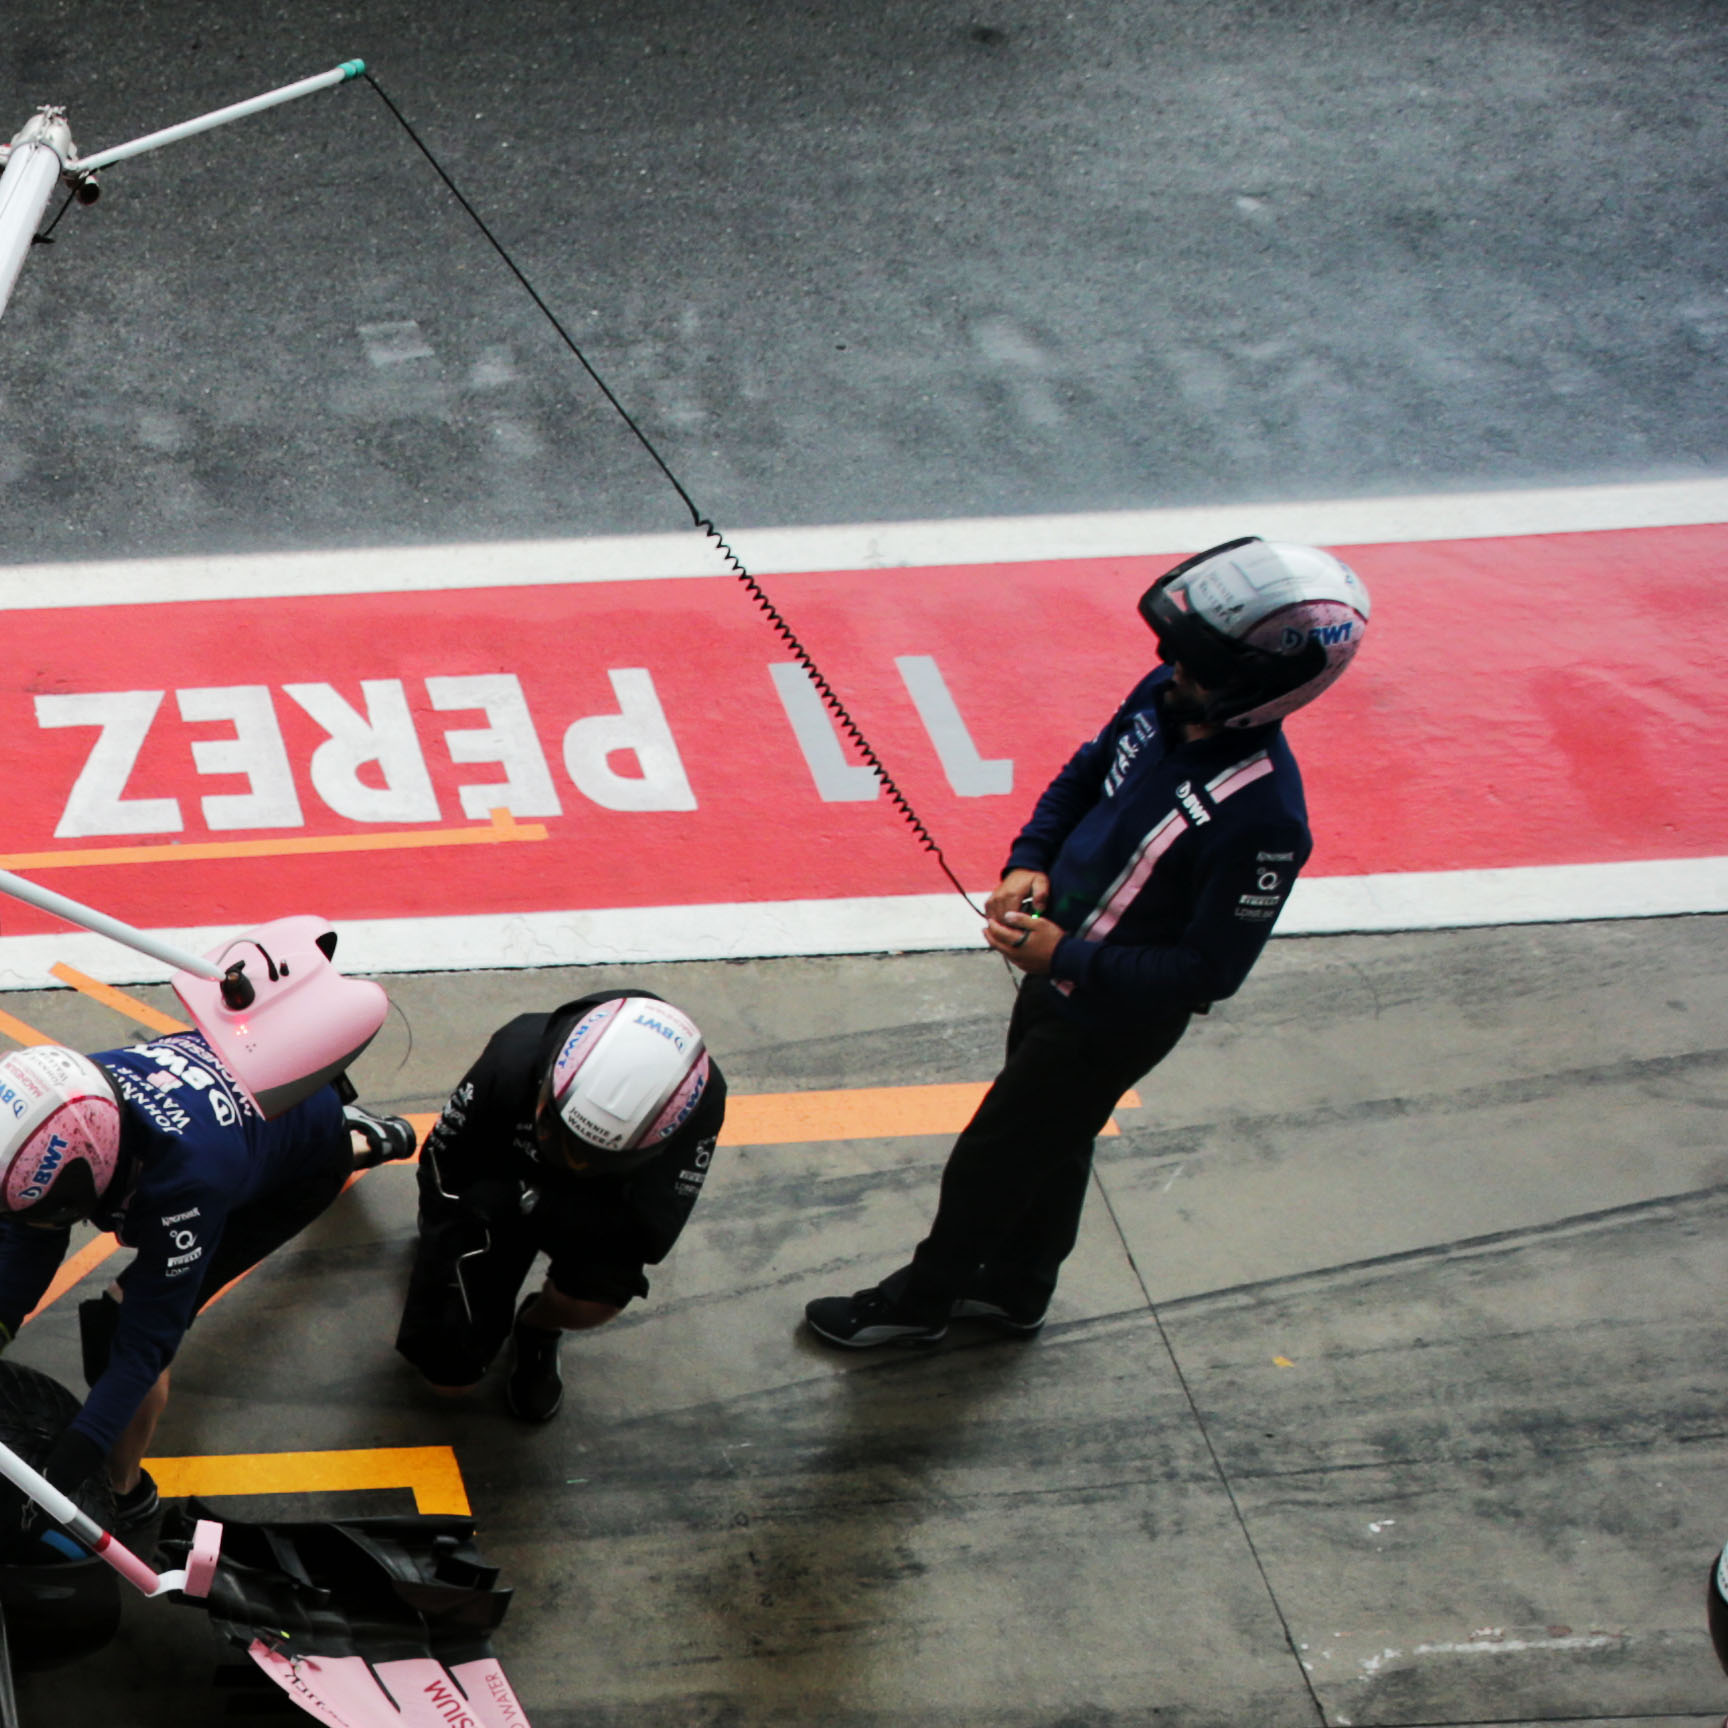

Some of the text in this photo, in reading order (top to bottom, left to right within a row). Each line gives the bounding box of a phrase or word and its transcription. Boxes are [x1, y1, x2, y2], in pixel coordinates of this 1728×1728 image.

[35, 667, 697, 839] PEREZ
[769, 656, 1014, 801] 11
[634, 1013, 674, 1042] BWT
[33, 1135, 68, 1186] BWT
[485, 1673, 518, 1723] WATER
